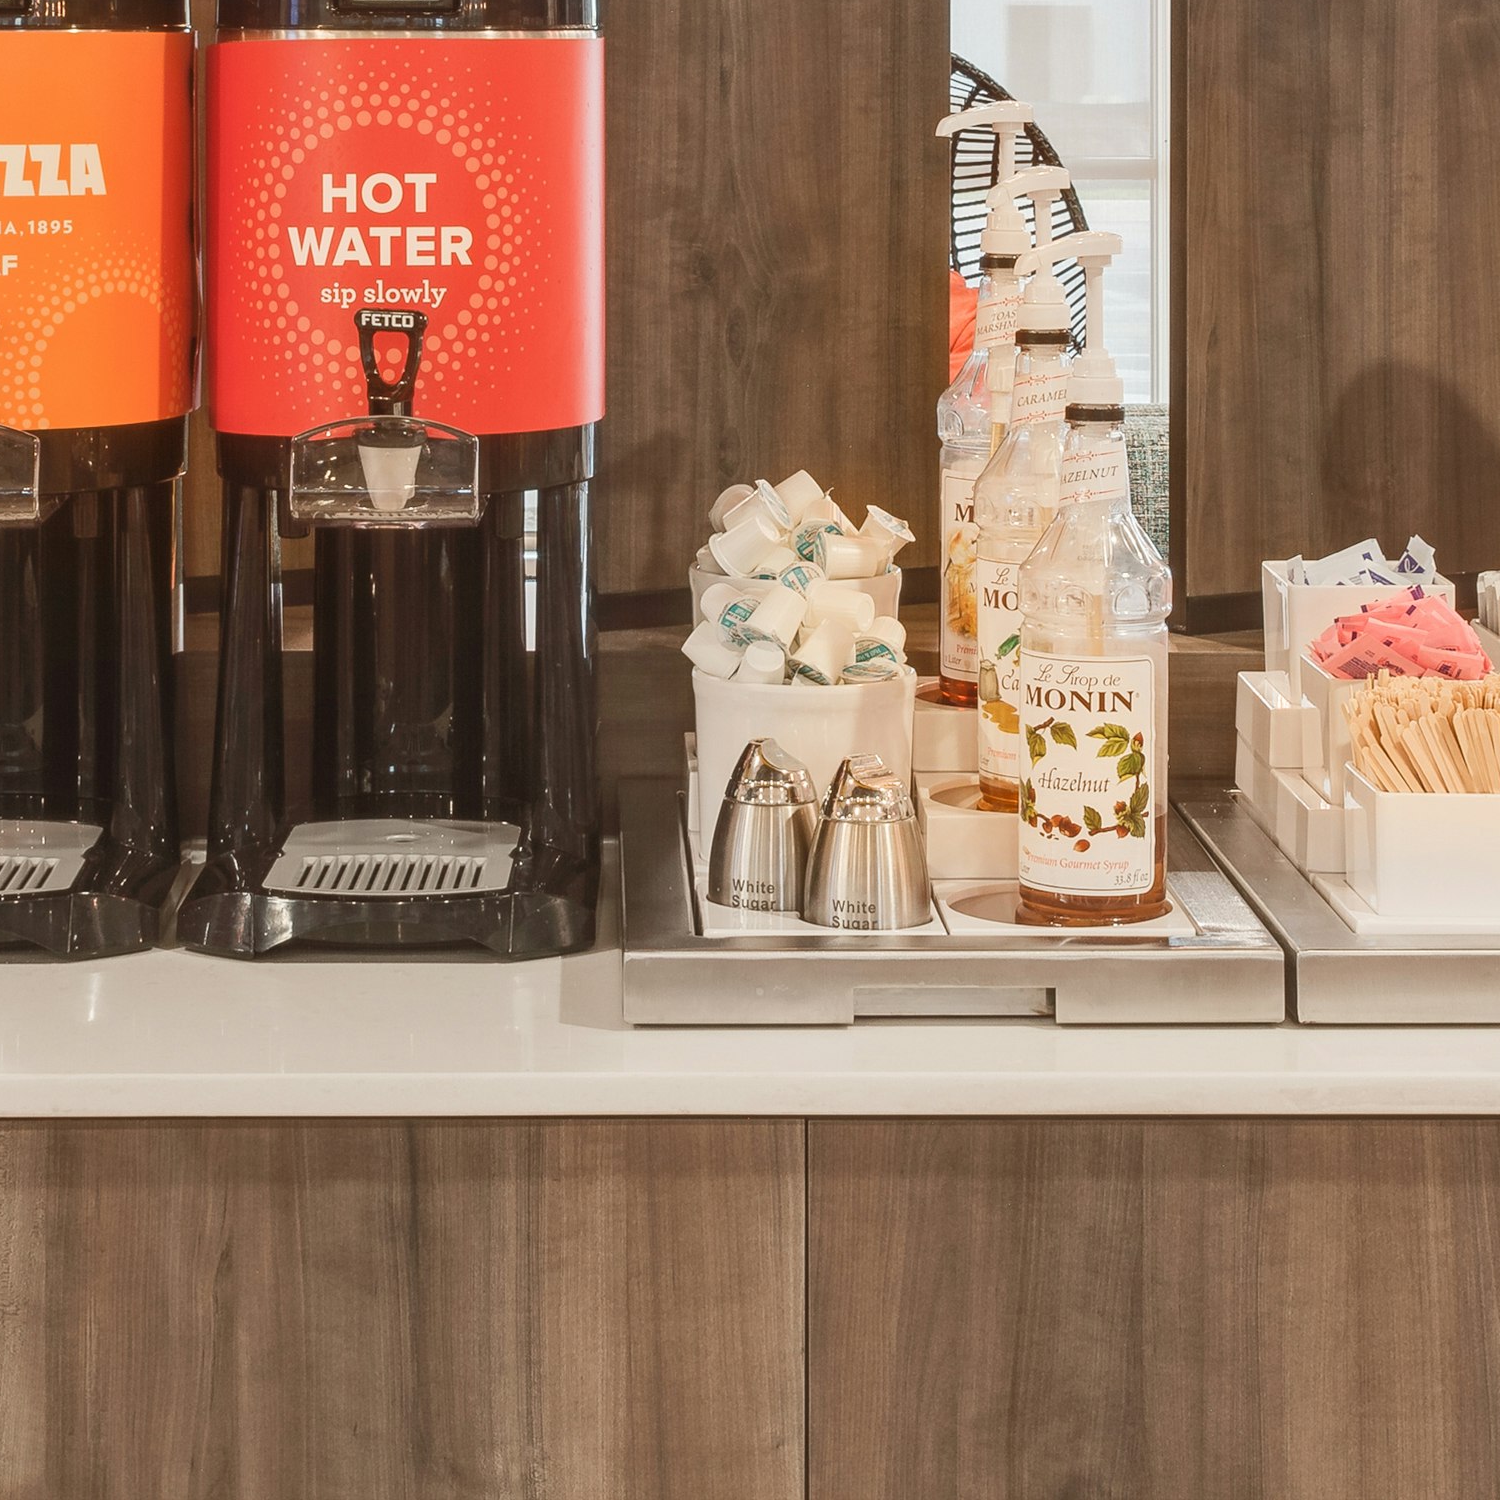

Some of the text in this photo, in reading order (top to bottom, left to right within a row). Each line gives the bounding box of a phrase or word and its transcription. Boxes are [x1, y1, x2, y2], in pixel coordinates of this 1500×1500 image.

[321, 172, 438, 214] HOT
[27, 218, 74, 236] 1895
[286, 225, 474, 267] WATER
[320, 280, 447, 312] sip slowly
[360, 312, 414, 329] FETCO
[990, 310, 1016, 322] TOAS
[976, 320, 1018, 337] MARSHM
[1060, 465, 1119, 485] AZELNUT
[956, 644, 978, 655] Premi
[1034, 663, 1052, 683] Le
[1056, 664, 1099, 688] Sirop
[1103, 674, 1121, 686] de
[1025, 684, 1135, 713] MONIN
[1038, 767, 1111, 793] Hazelnut
[1059, 857, 1101, 870] Gourmet
[1103, 859, 1130, 875] Syrup
[732, 878, 775, 894] White
[1113, 872, 1132, 886] 33.8
[731, 895, 777, 912] Sugar
[832, 899, 877, 914] White
[831, 915, 878, 930] Sugar
